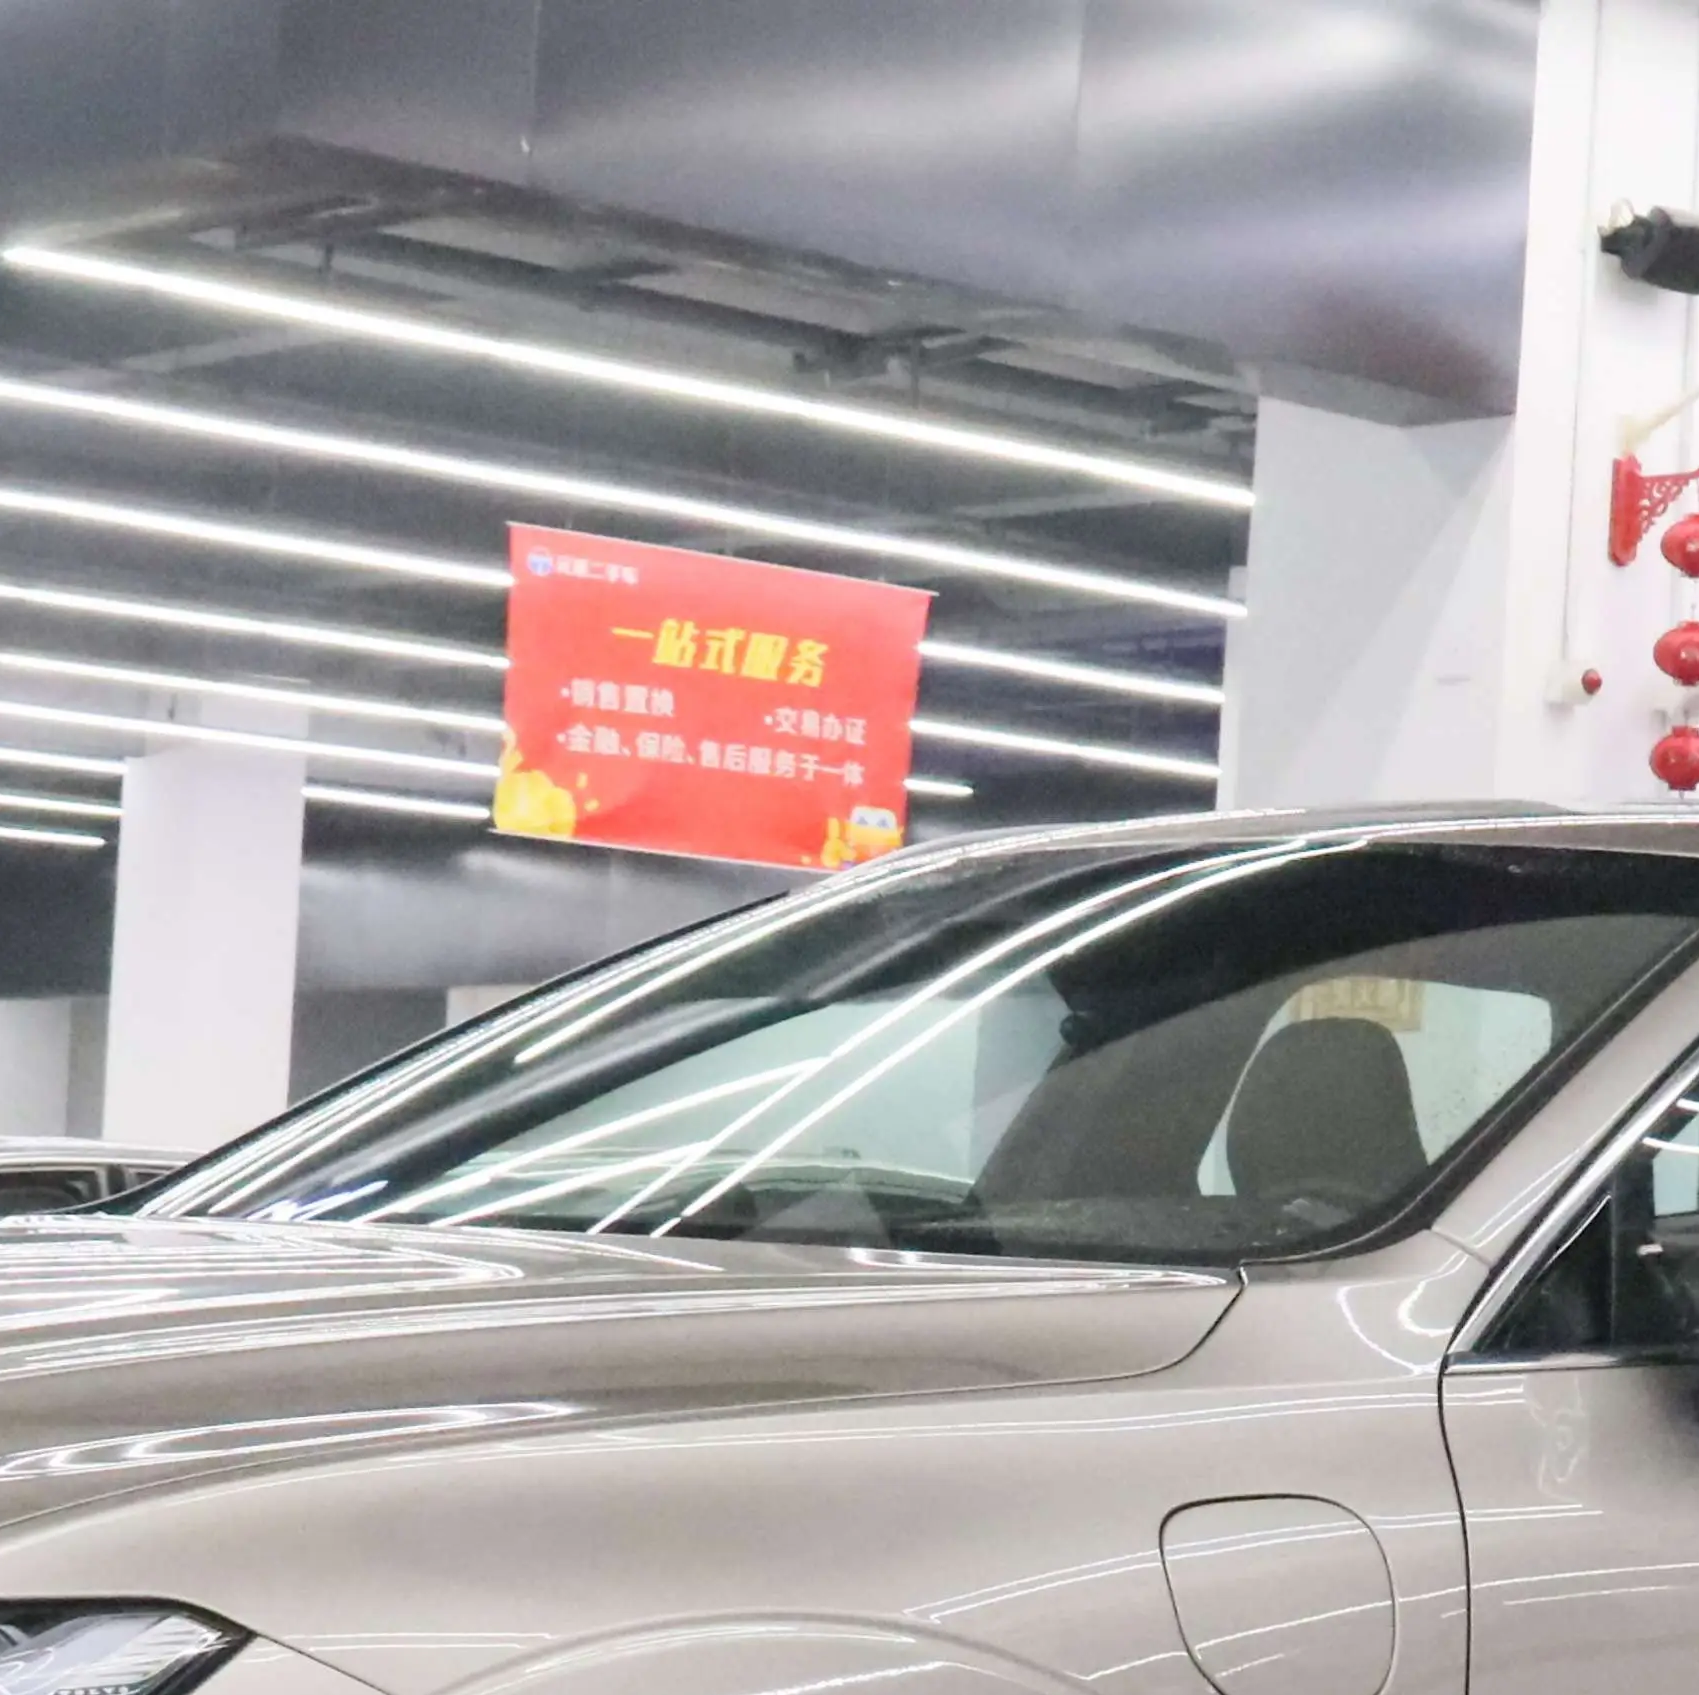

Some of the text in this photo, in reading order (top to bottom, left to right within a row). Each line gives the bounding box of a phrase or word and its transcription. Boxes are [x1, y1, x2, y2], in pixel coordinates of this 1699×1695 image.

[611, 618, 828, 687] 一站式服务
[571, 678, 675, 717] 销售置换
[775, 706, 866, 745] 交易办证
